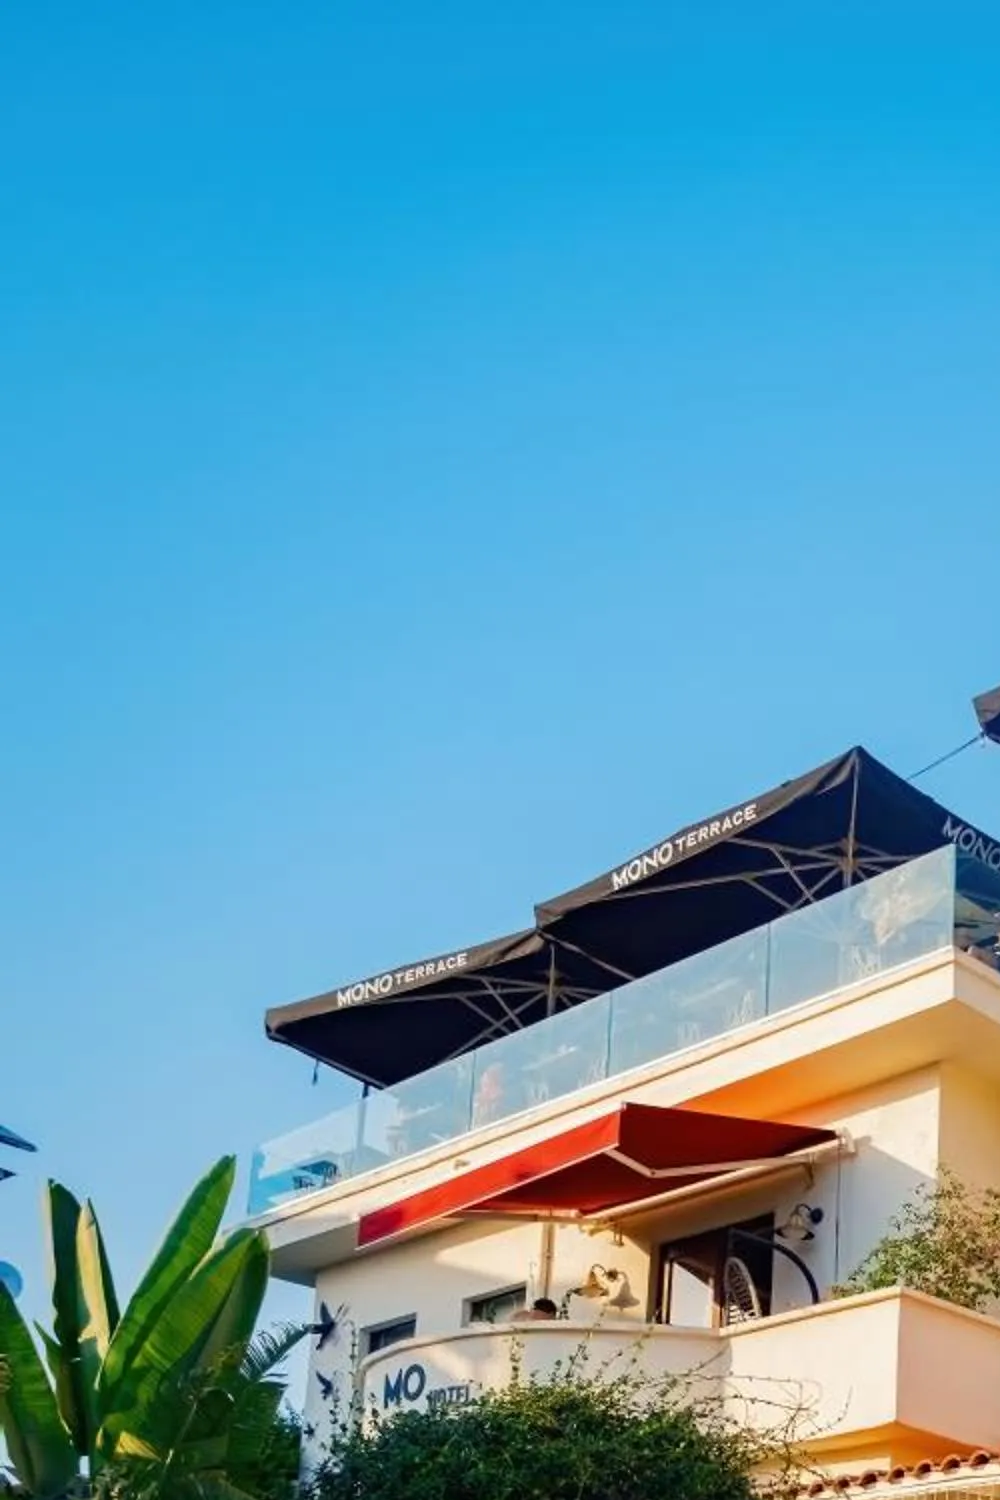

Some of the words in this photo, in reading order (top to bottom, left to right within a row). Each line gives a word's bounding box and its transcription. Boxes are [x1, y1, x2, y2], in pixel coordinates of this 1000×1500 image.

[611, 841, 673, 891] MONO
[675, 804, 757, 852] TERRACE
[336, 974, 393, 1008] MONO
[396, 953, 467, 985] TERRACE
[384, 1364, 426, 1409] MO
